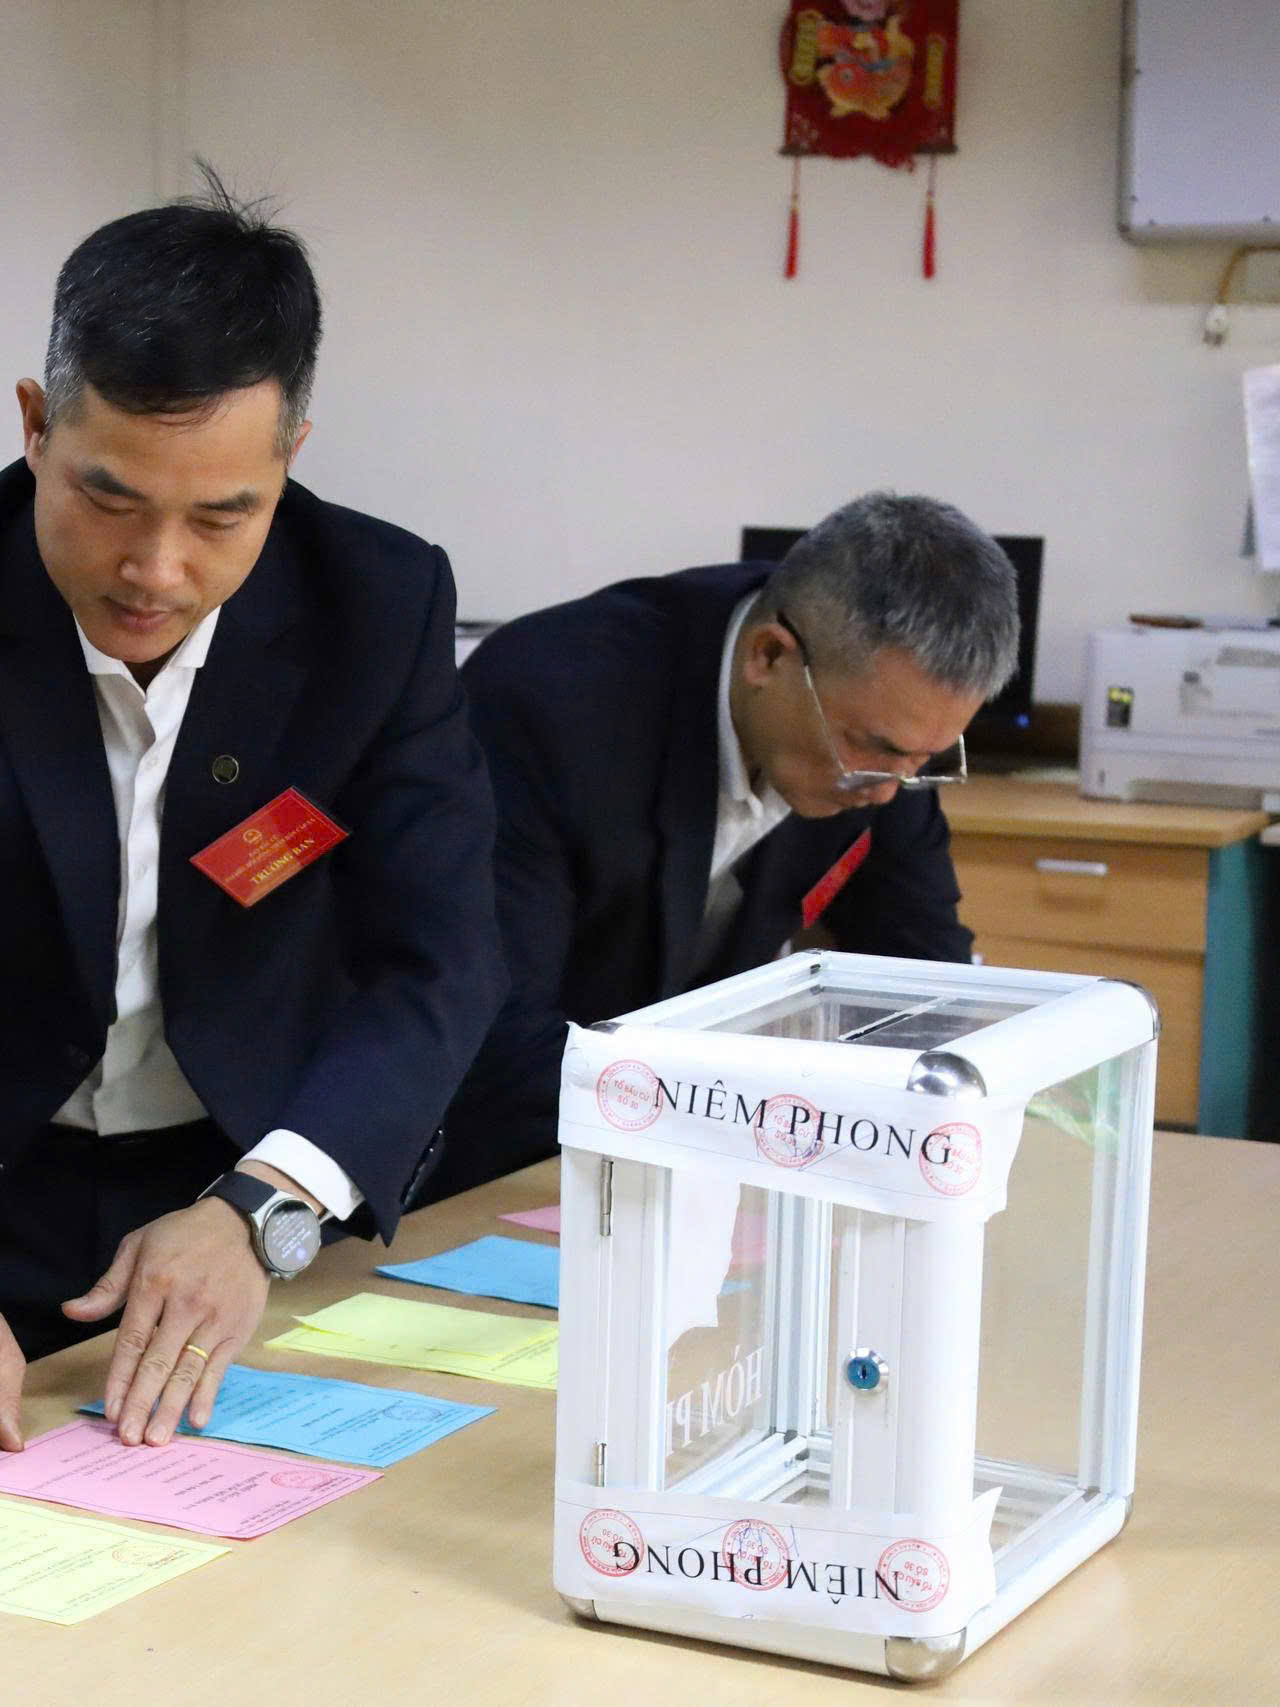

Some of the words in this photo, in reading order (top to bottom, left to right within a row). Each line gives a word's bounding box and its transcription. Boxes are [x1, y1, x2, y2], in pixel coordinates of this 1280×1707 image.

[654, 1077, 768, 1128] NIÊM
[787, 1105, 951, 1165] PHONG
[613, 1541, 765, 1586] PHONG
[785, 1559, 904, 1604] NIÊM
